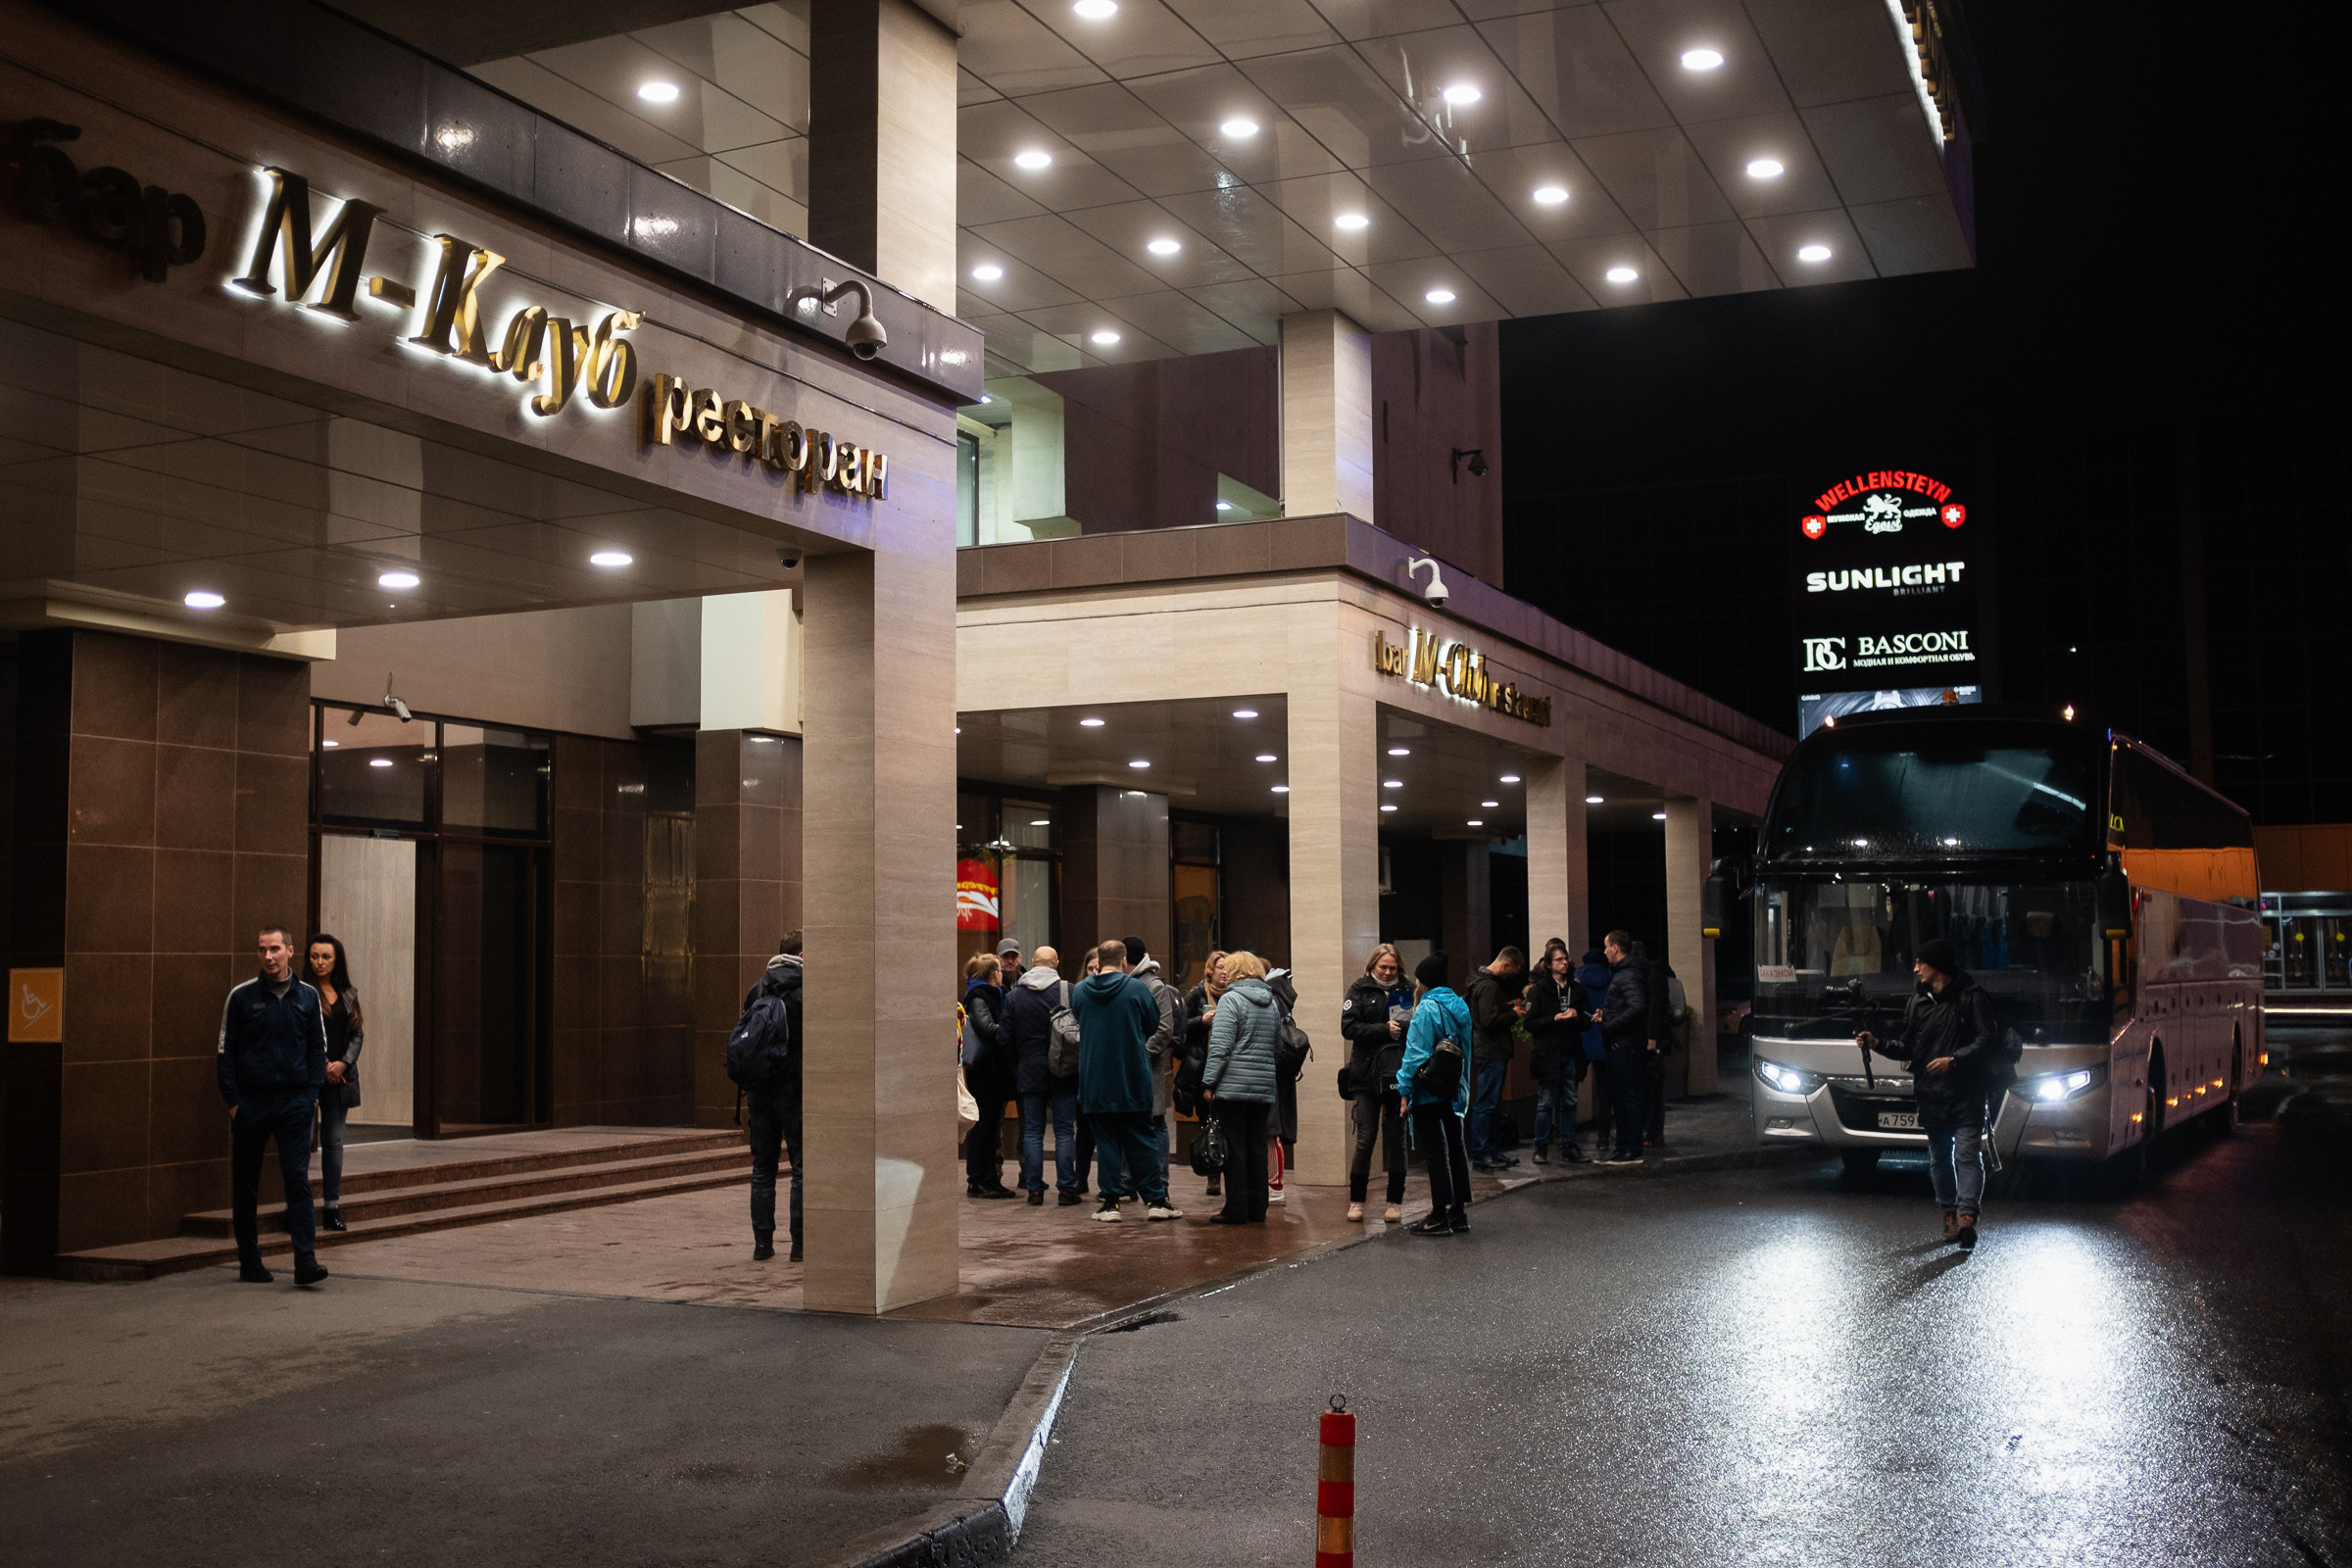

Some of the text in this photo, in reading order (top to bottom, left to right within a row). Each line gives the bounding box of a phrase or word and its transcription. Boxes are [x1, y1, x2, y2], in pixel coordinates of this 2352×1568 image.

[2, 116, 889, 502] бар М-Клуб ресторан
[1814, 469, 1952, 513] WELLENSTEYN
[1806, 561, 1966, 593] SUNLIGHT
[1892, 585, 1946, 597] BRILLIANT
[1376, 630, 1408, 677] bar
[1853, 652, 1976, 667] МОДНАЯ И КОМФОРТНАЯ ОБУВЬ
[1858, 630, 1969, 657] BASCONI
